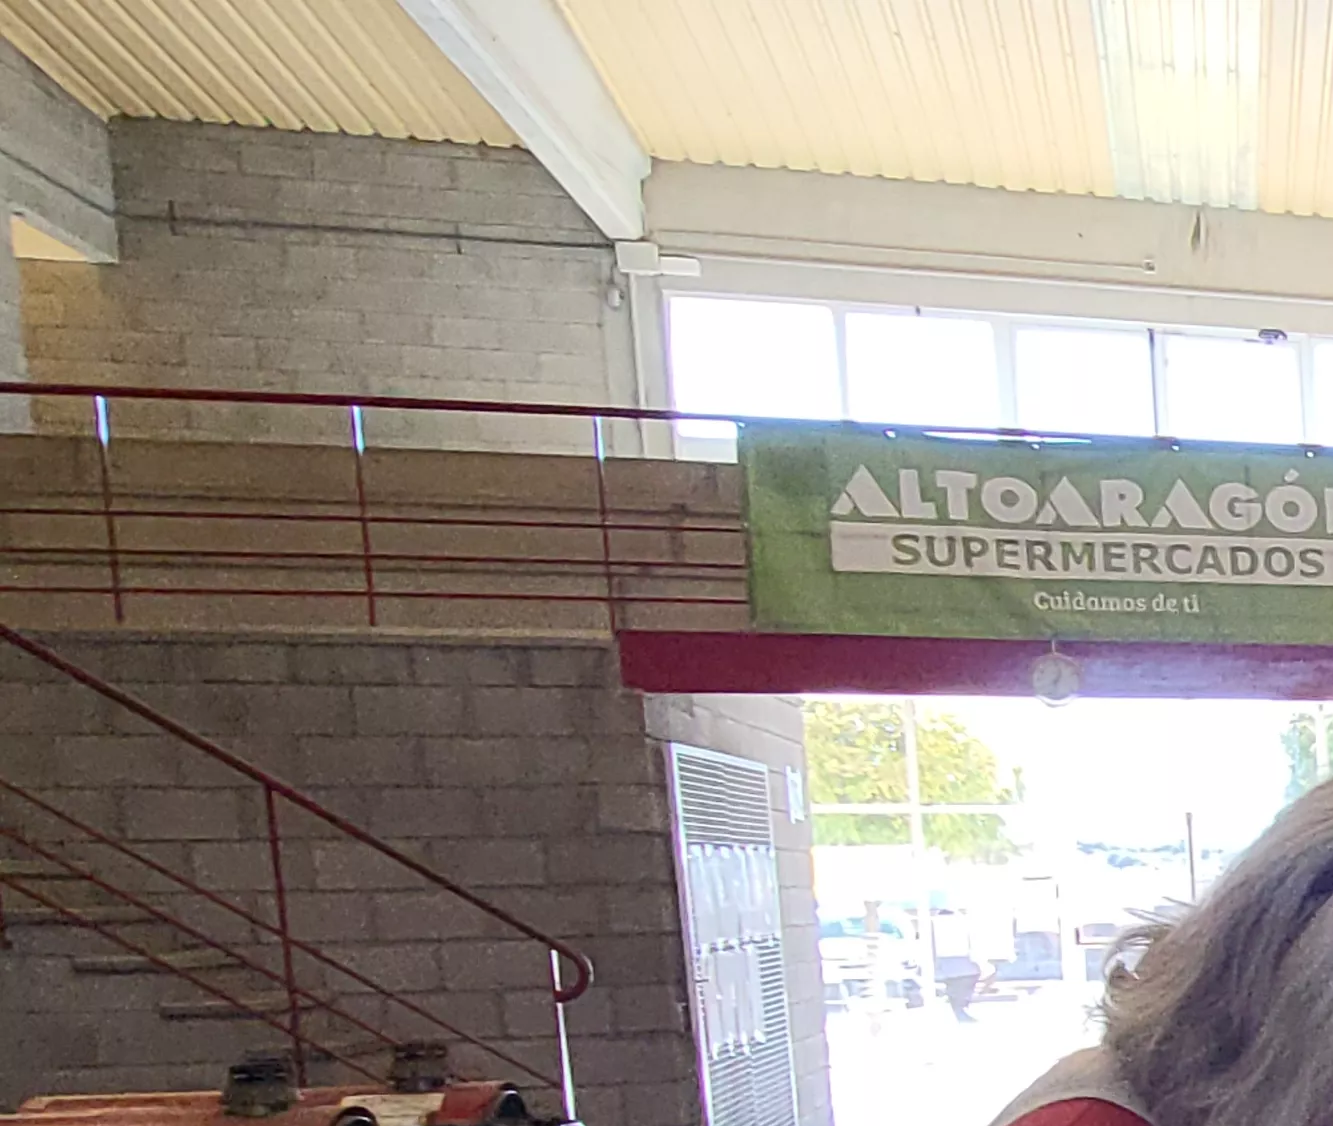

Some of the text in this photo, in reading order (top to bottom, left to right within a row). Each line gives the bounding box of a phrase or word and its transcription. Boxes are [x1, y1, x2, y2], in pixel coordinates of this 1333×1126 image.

[891, 533, 1326, 578] SUPERMERCADOS
[1033, 590, 1200, 615] Cuidamos de ti
